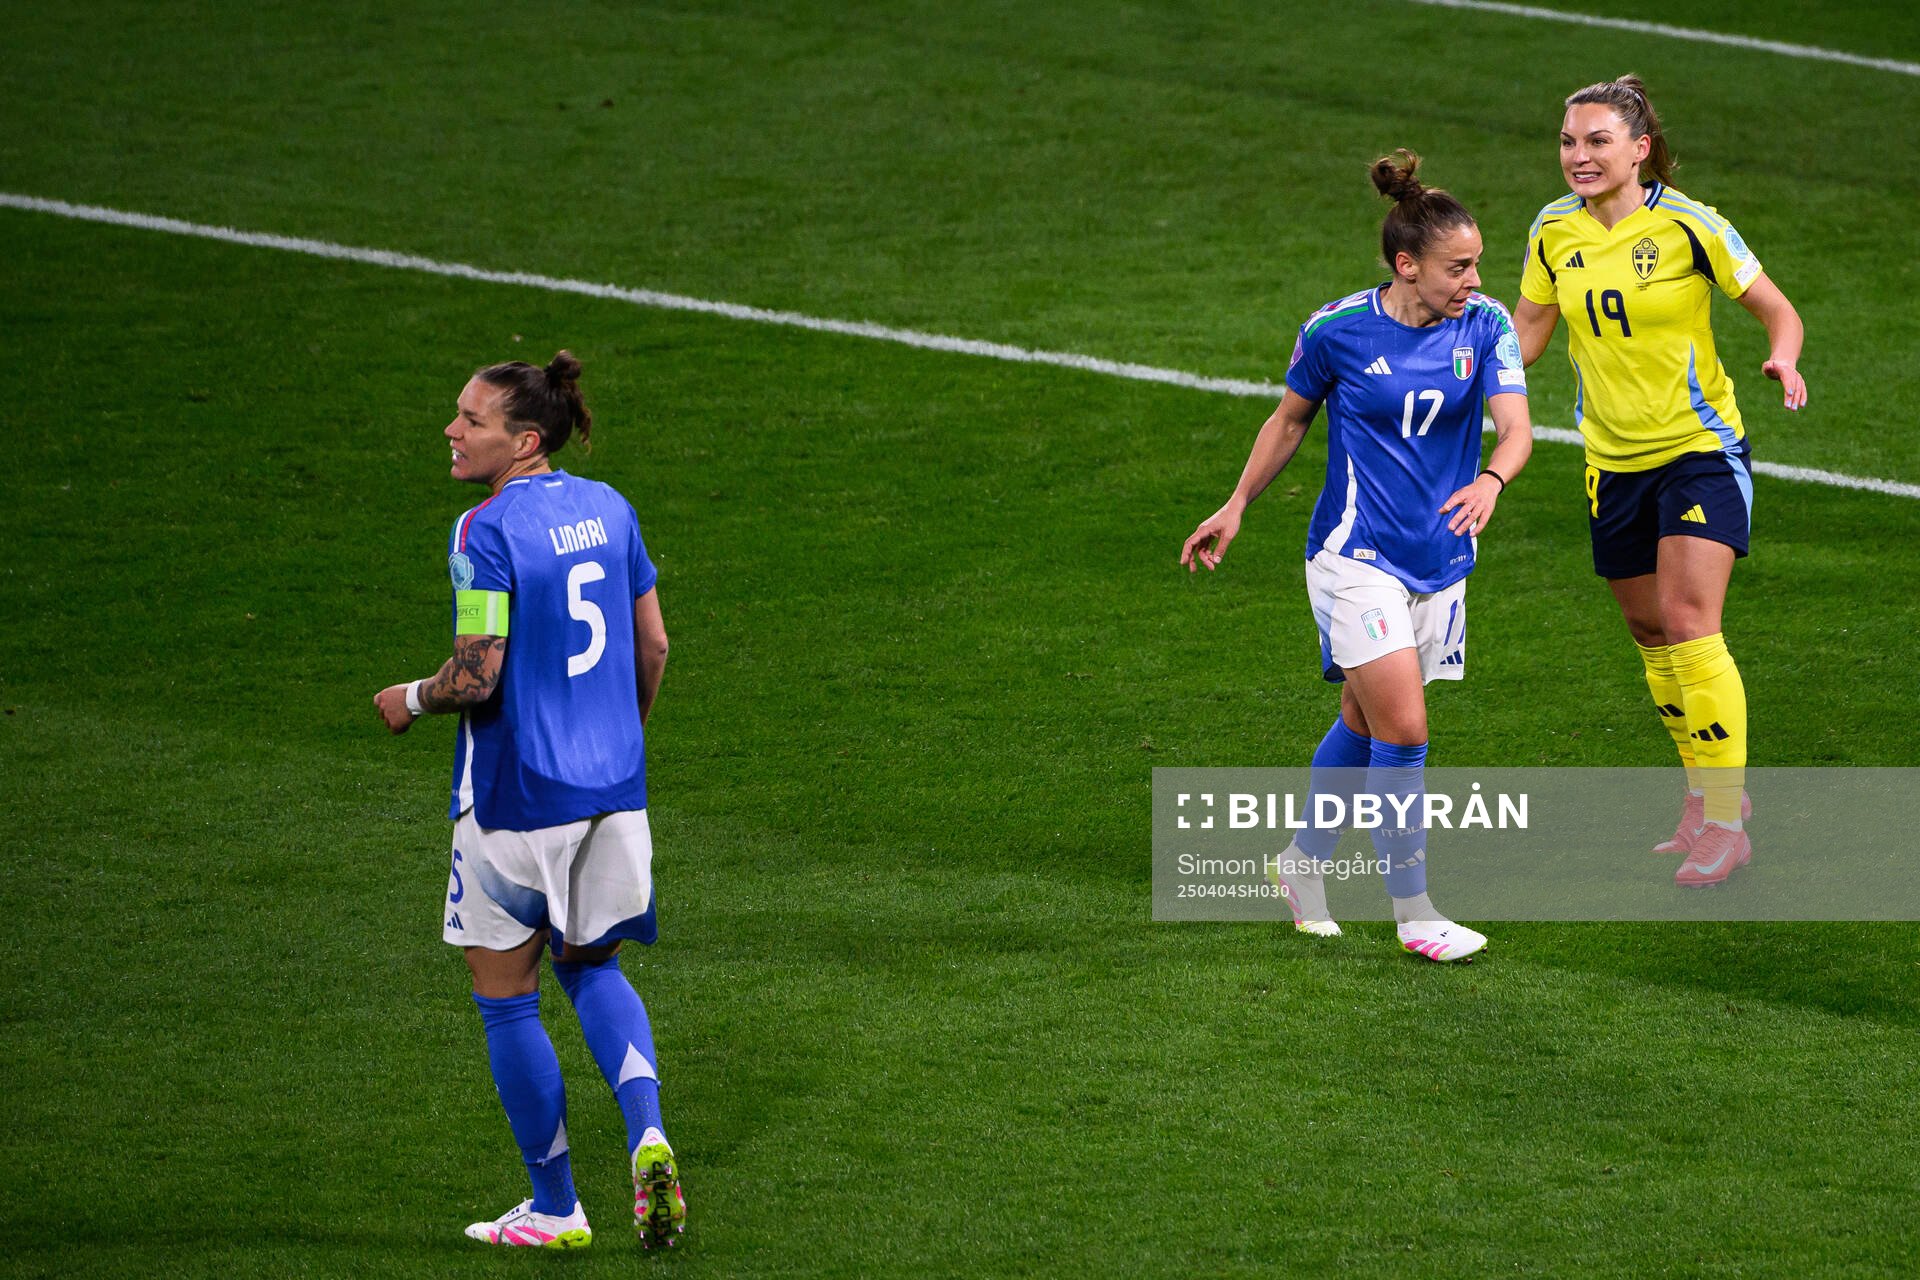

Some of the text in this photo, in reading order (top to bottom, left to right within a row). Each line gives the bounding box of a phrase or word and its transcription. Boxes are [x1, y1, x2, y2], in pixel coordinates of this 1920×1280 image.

[1586, 289, 1632, 338] 19
[1402, 389, 1444, 438] 17
[549, 517, 607, 555] LINARI
[567, 561, 606, 677] 5
[450, 849, 464, 904] 5
